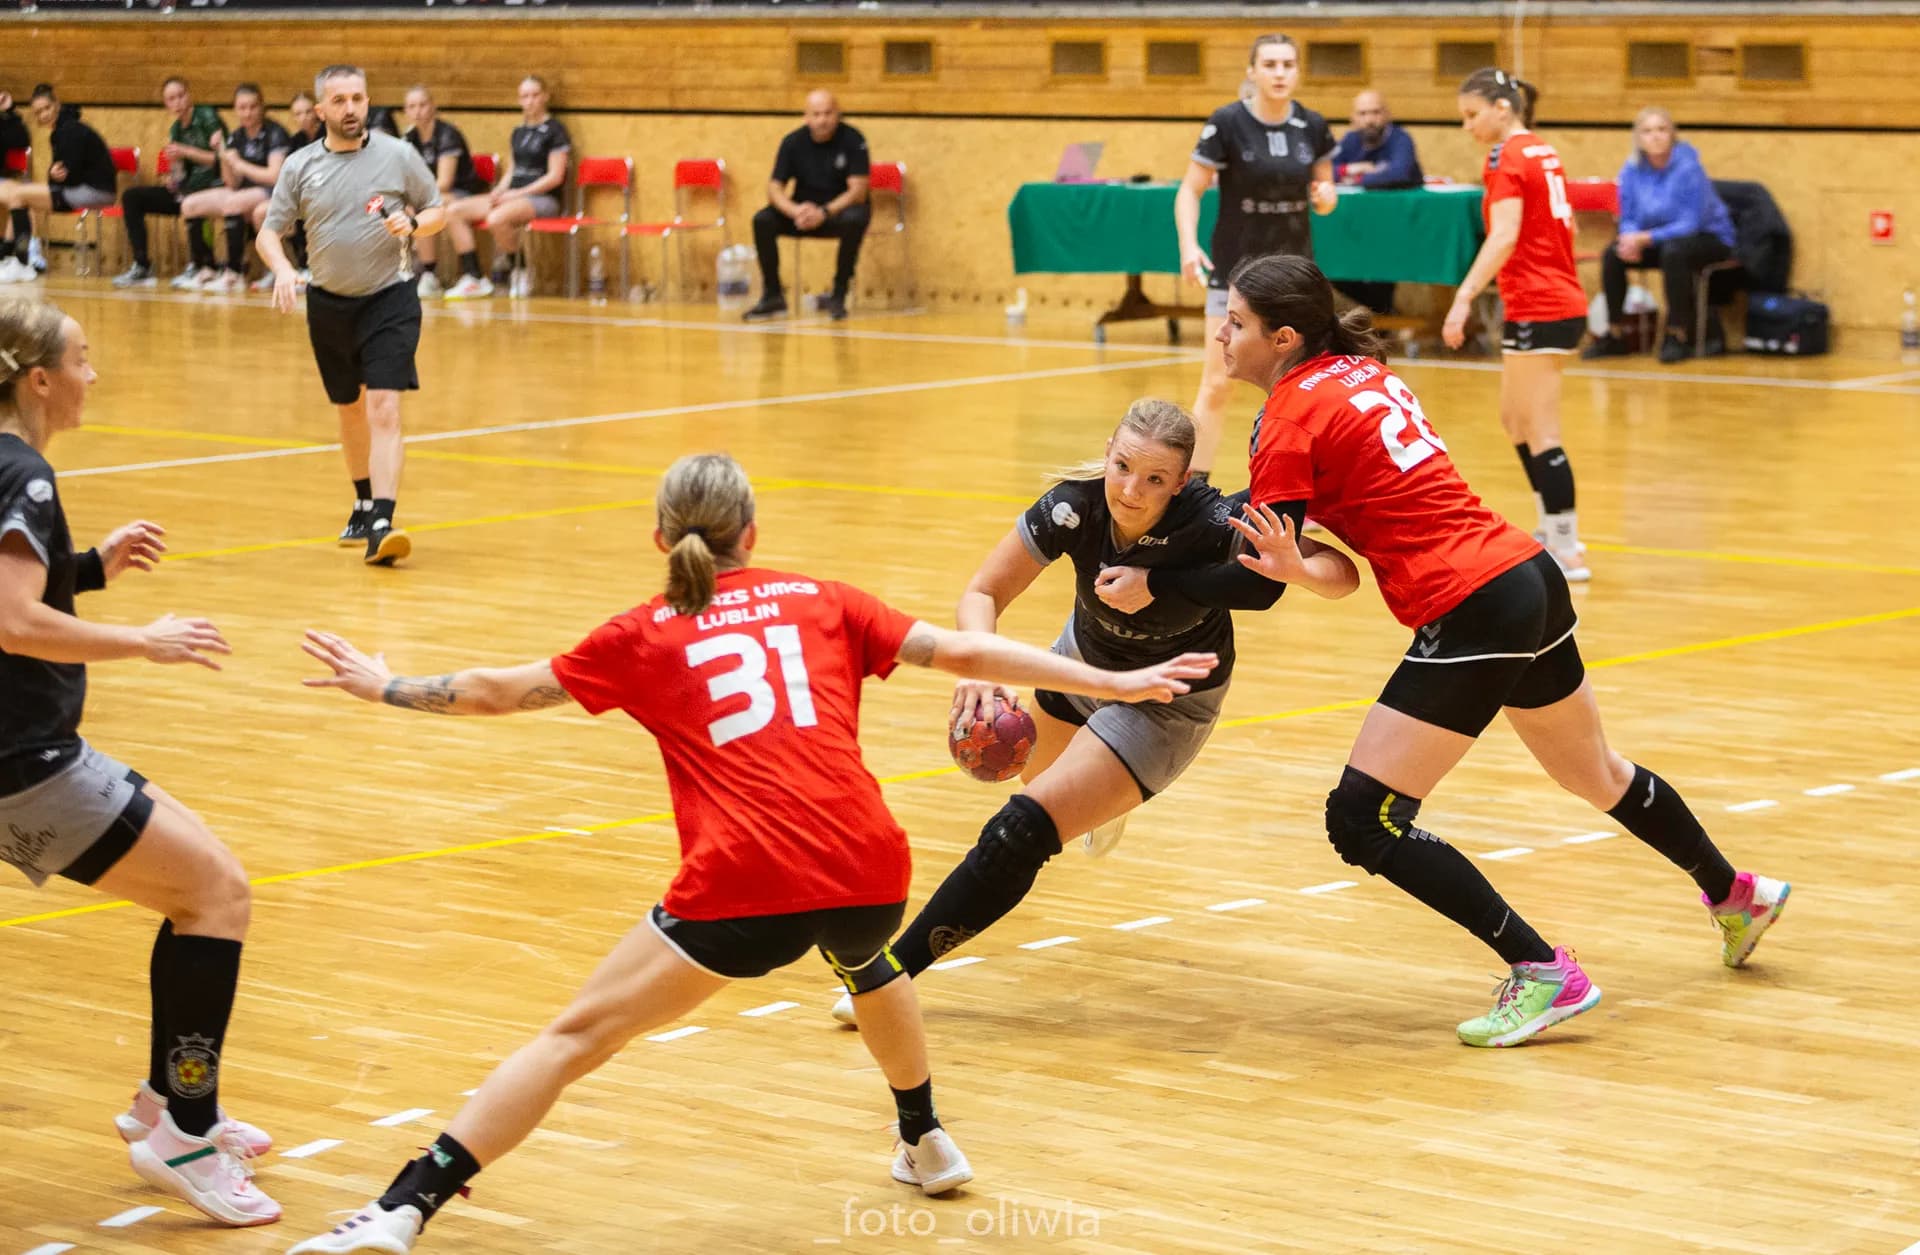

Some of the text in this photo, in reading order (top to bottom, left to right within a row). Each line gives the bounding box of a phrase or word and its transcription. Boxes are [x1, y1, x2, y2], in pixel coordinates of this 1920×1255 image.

[1338, 363, 1381, 388] LUBLIN
[1348, 374, 1448, 473] 28
[753, 582, 819, 598] UMCS
[696, 602, 780, 631] LUBLIN
[685, 624, 818, 747] 31
